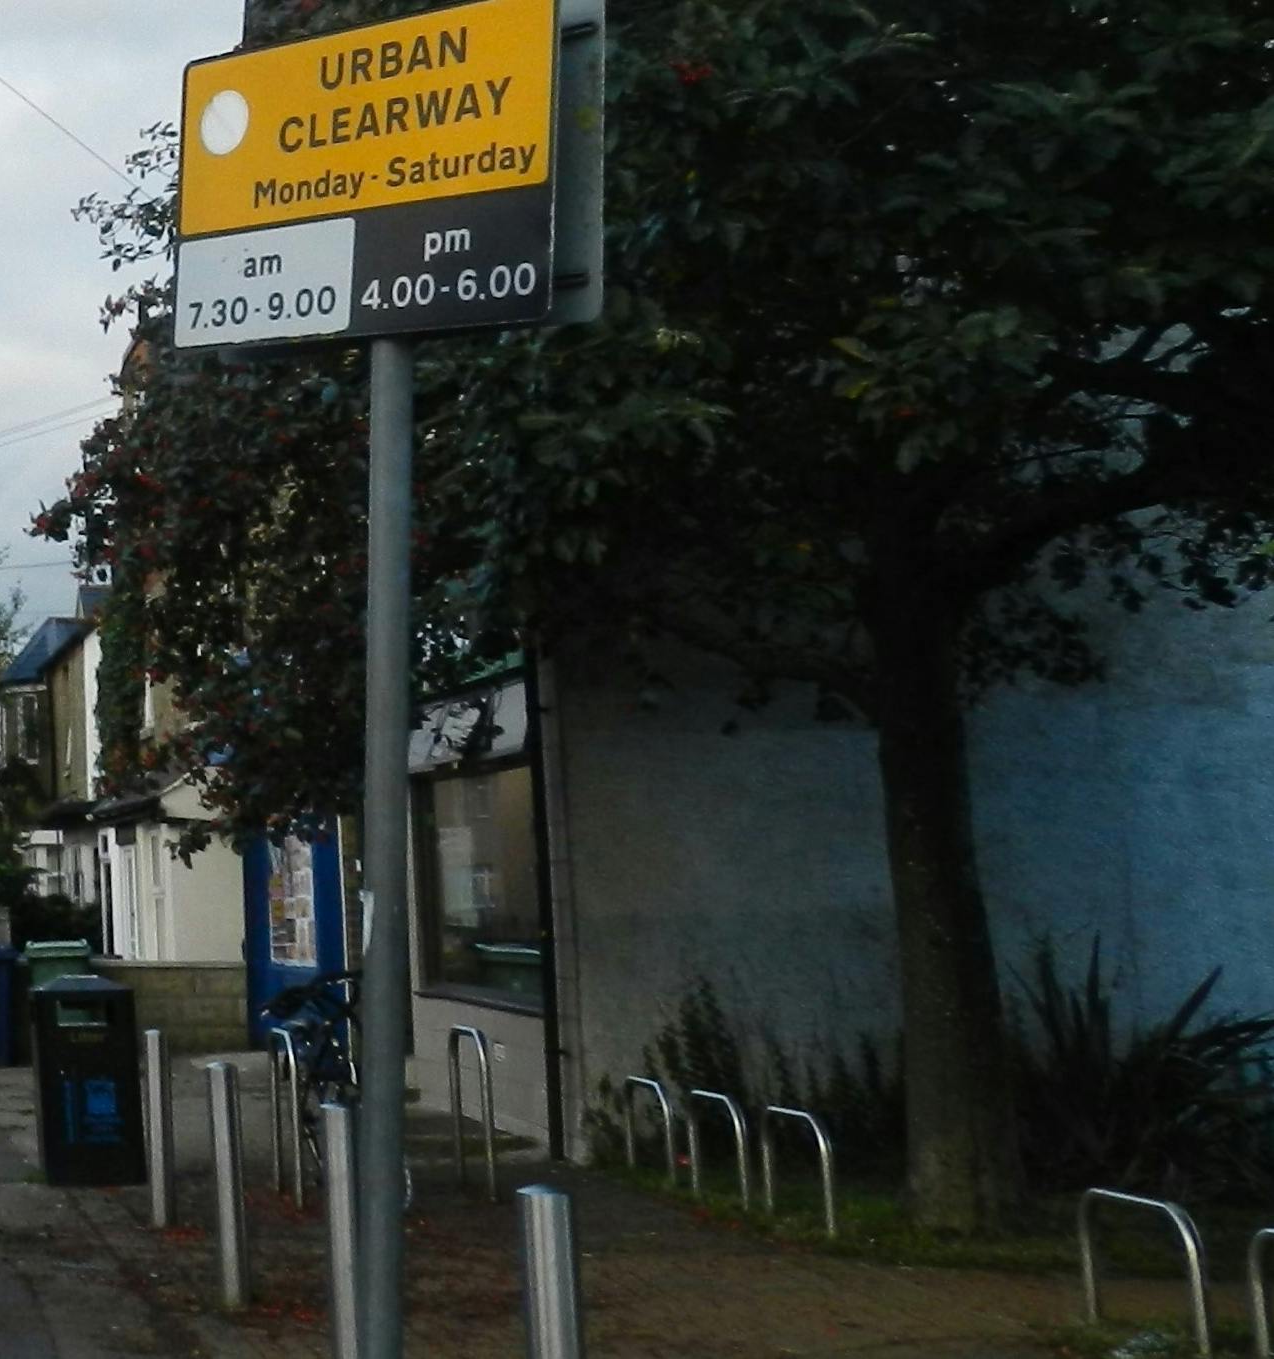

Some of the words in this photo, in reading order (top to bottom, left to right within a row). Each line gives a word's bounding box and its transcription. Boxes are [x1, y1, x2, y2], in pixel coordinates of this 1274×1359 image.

[319, 26, 469, 91] URBAN
[278, 76, 513, 154] CLEARWAY
[253, 169, 365, 209] Monday
[385, 142, 537, 188] Saturday
[243, 254, 283, 278] am
[423, 228, 471, 262] pm
